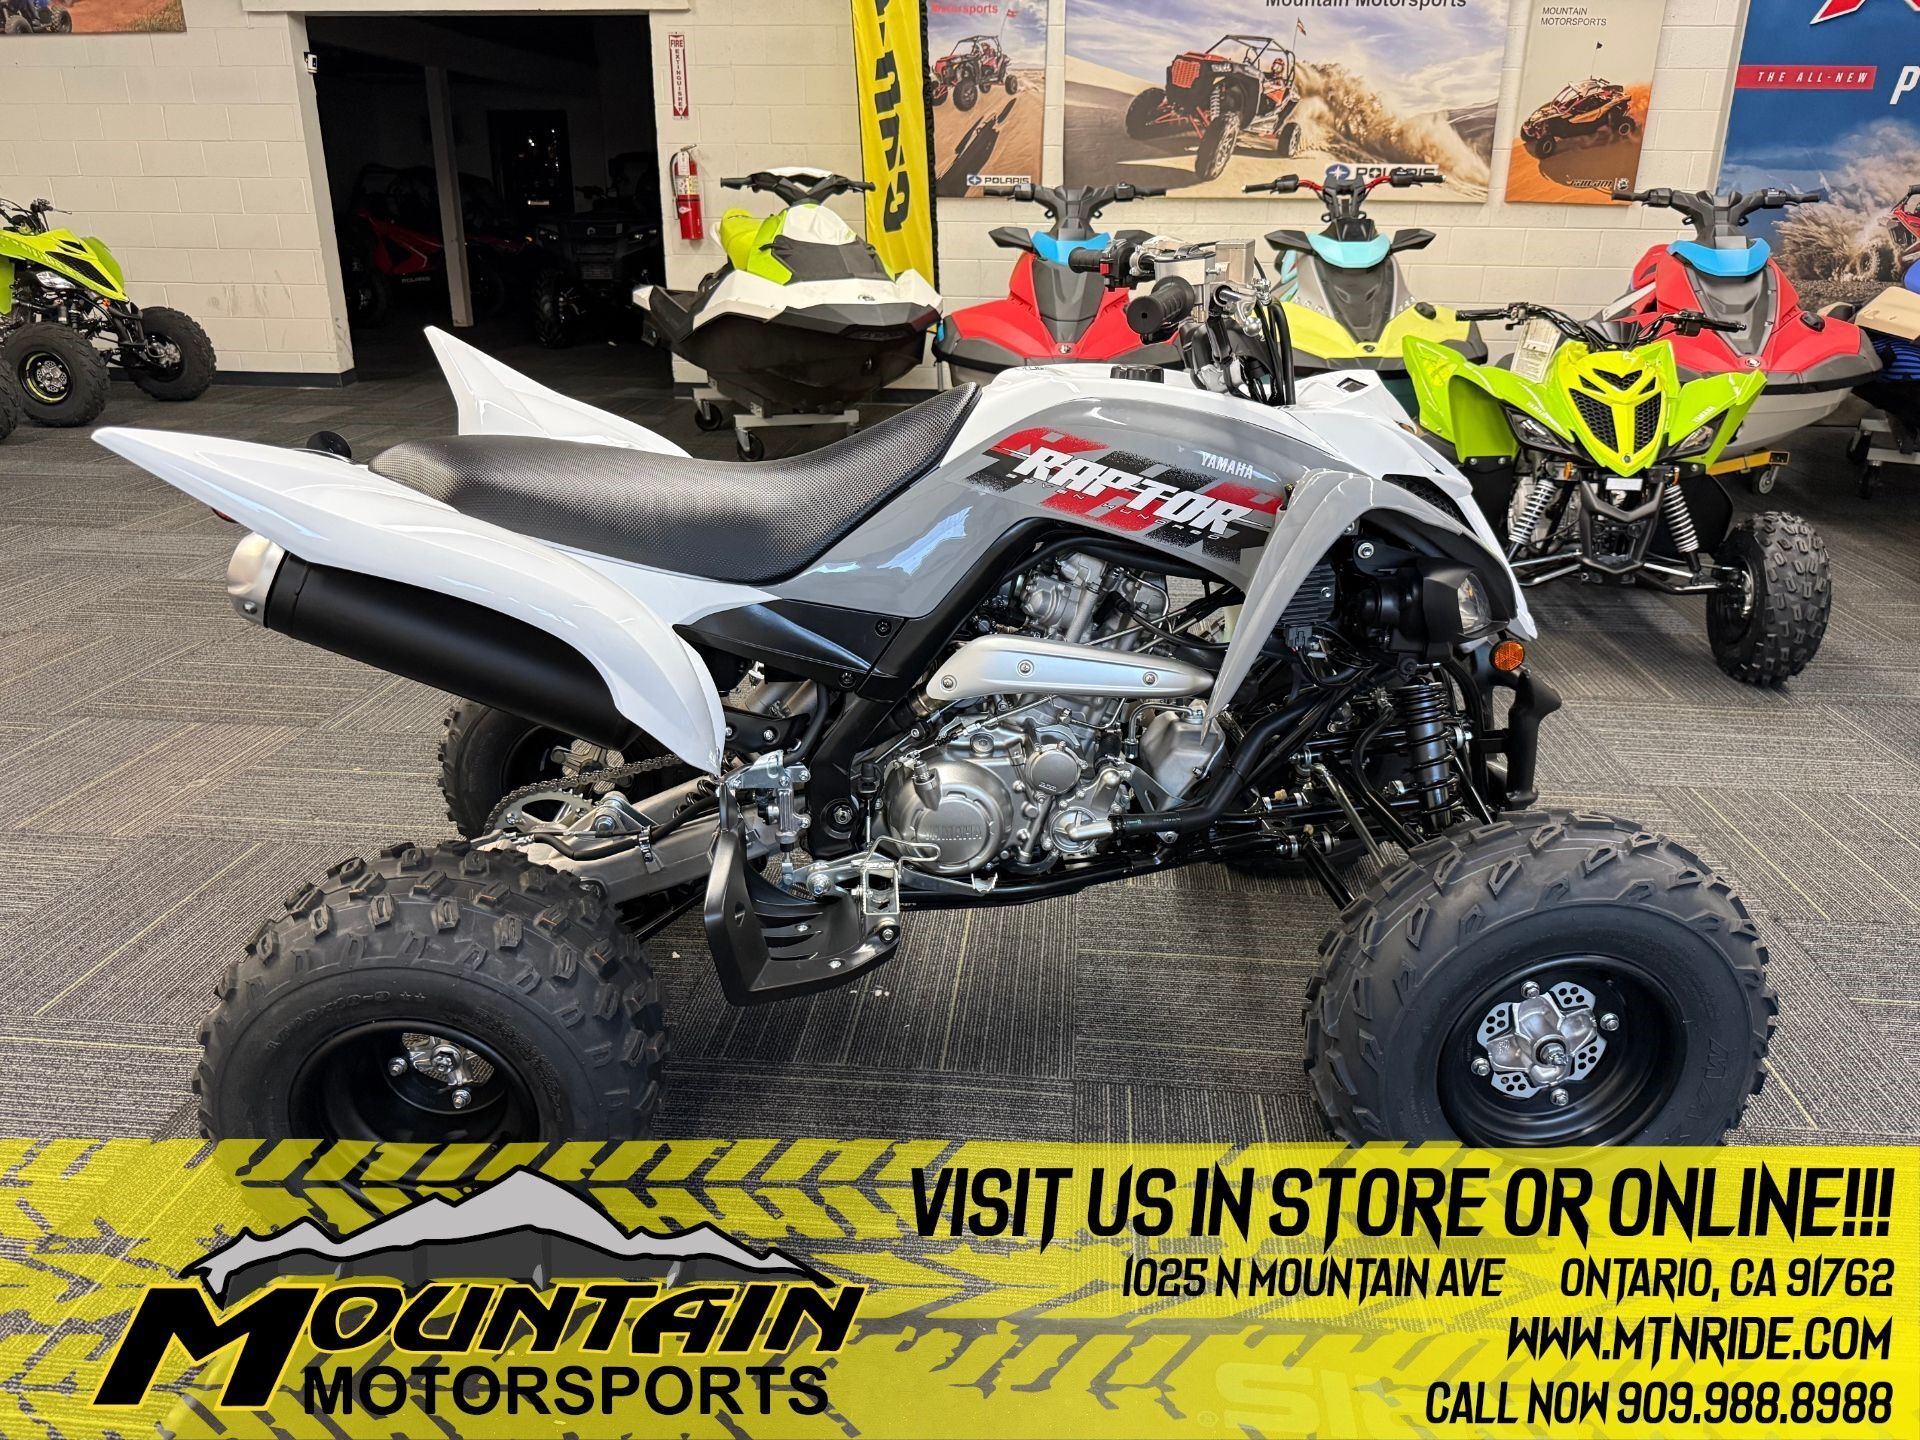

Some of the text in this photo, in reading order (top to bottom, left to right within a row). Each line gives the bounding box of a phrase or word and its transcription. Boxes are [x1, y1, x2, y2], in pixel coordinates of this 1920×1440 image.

[1542, 7, 1588, 15] MOUNTAIN
[1541, 17, 1607, 26] MOTORSPORTS
[670, 39, 684, 48] FIRE
[674, 48, 684, 112] EXTINGUISHER
[1757, 71, 1869, 83] THE ALL-NEW
[984, 176, 1030, 185] POLARIS
[1201, 451, 1254, 480] YAMAHA
[1012, 446, 1254, 535] RAPTOR
